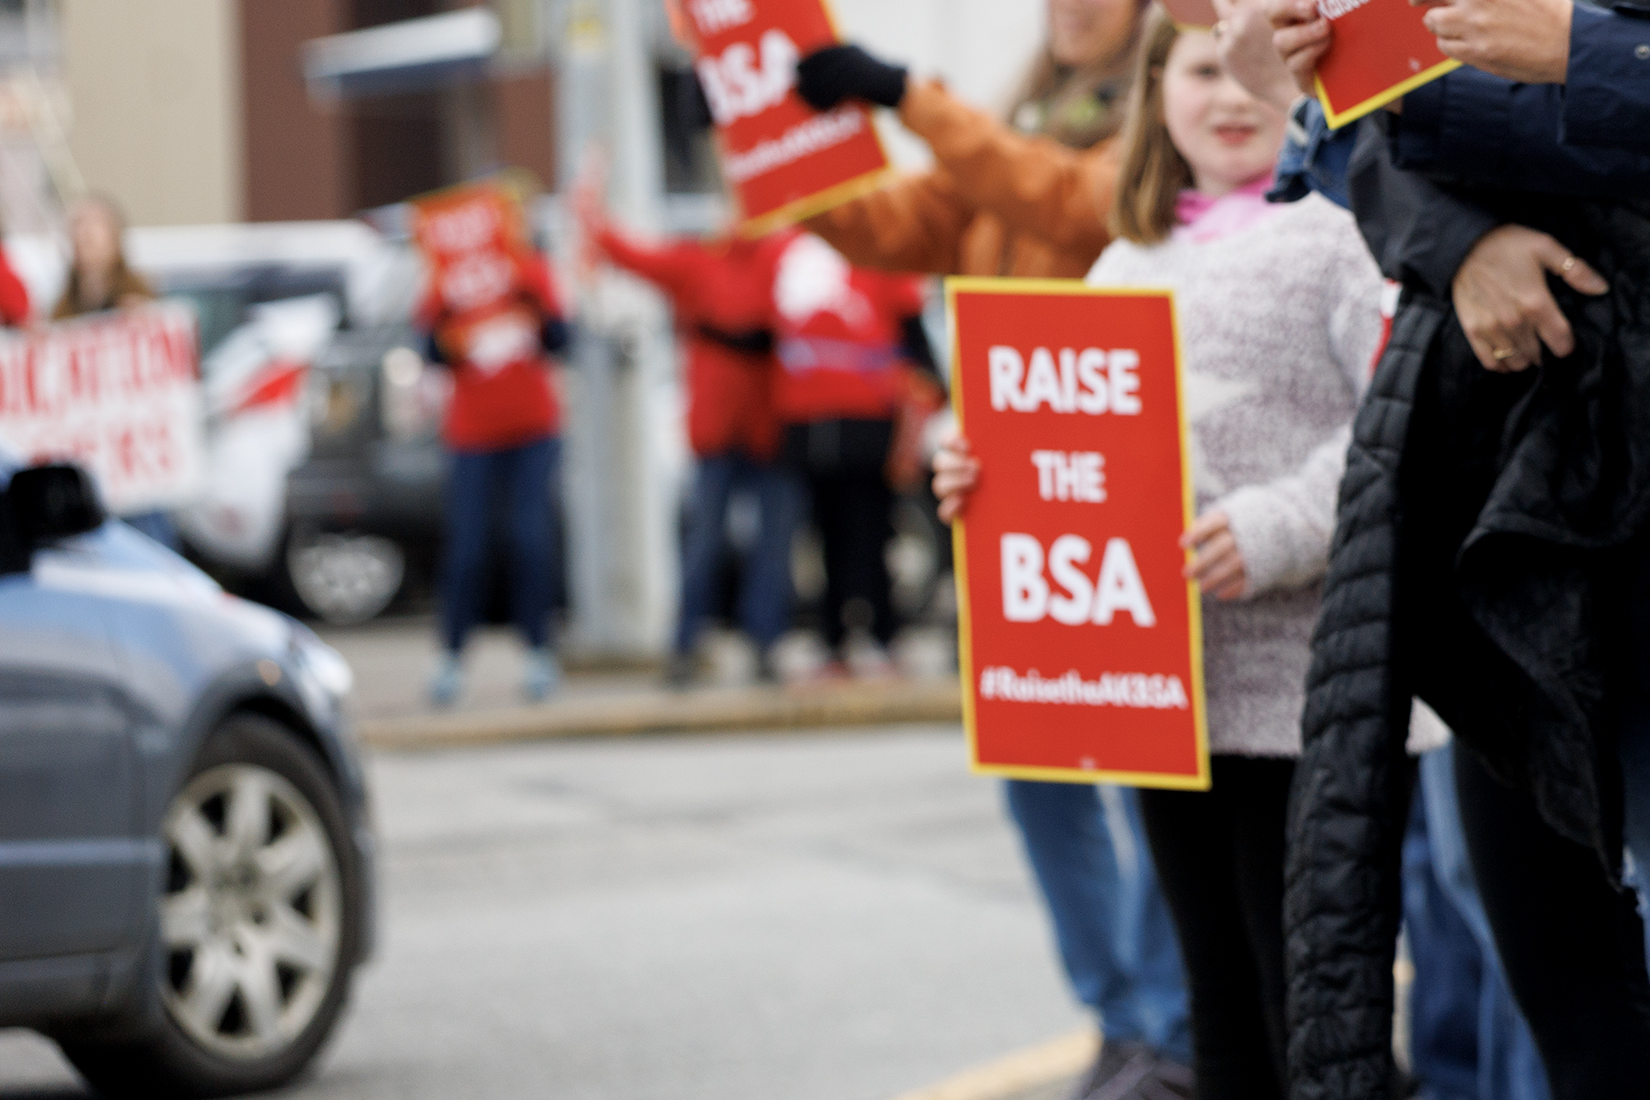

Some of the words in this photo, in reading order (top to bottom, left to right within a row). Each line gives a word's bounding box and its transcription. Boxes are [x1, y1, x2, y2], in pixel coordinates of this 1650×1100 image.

[987, 345, 1142, 415] RAISE
[1031, 450, 1107, 503] THE
[1000, 533, 1156, 628] BSA
[980, 666, 1188, 709] #RaisetheAKBSA
